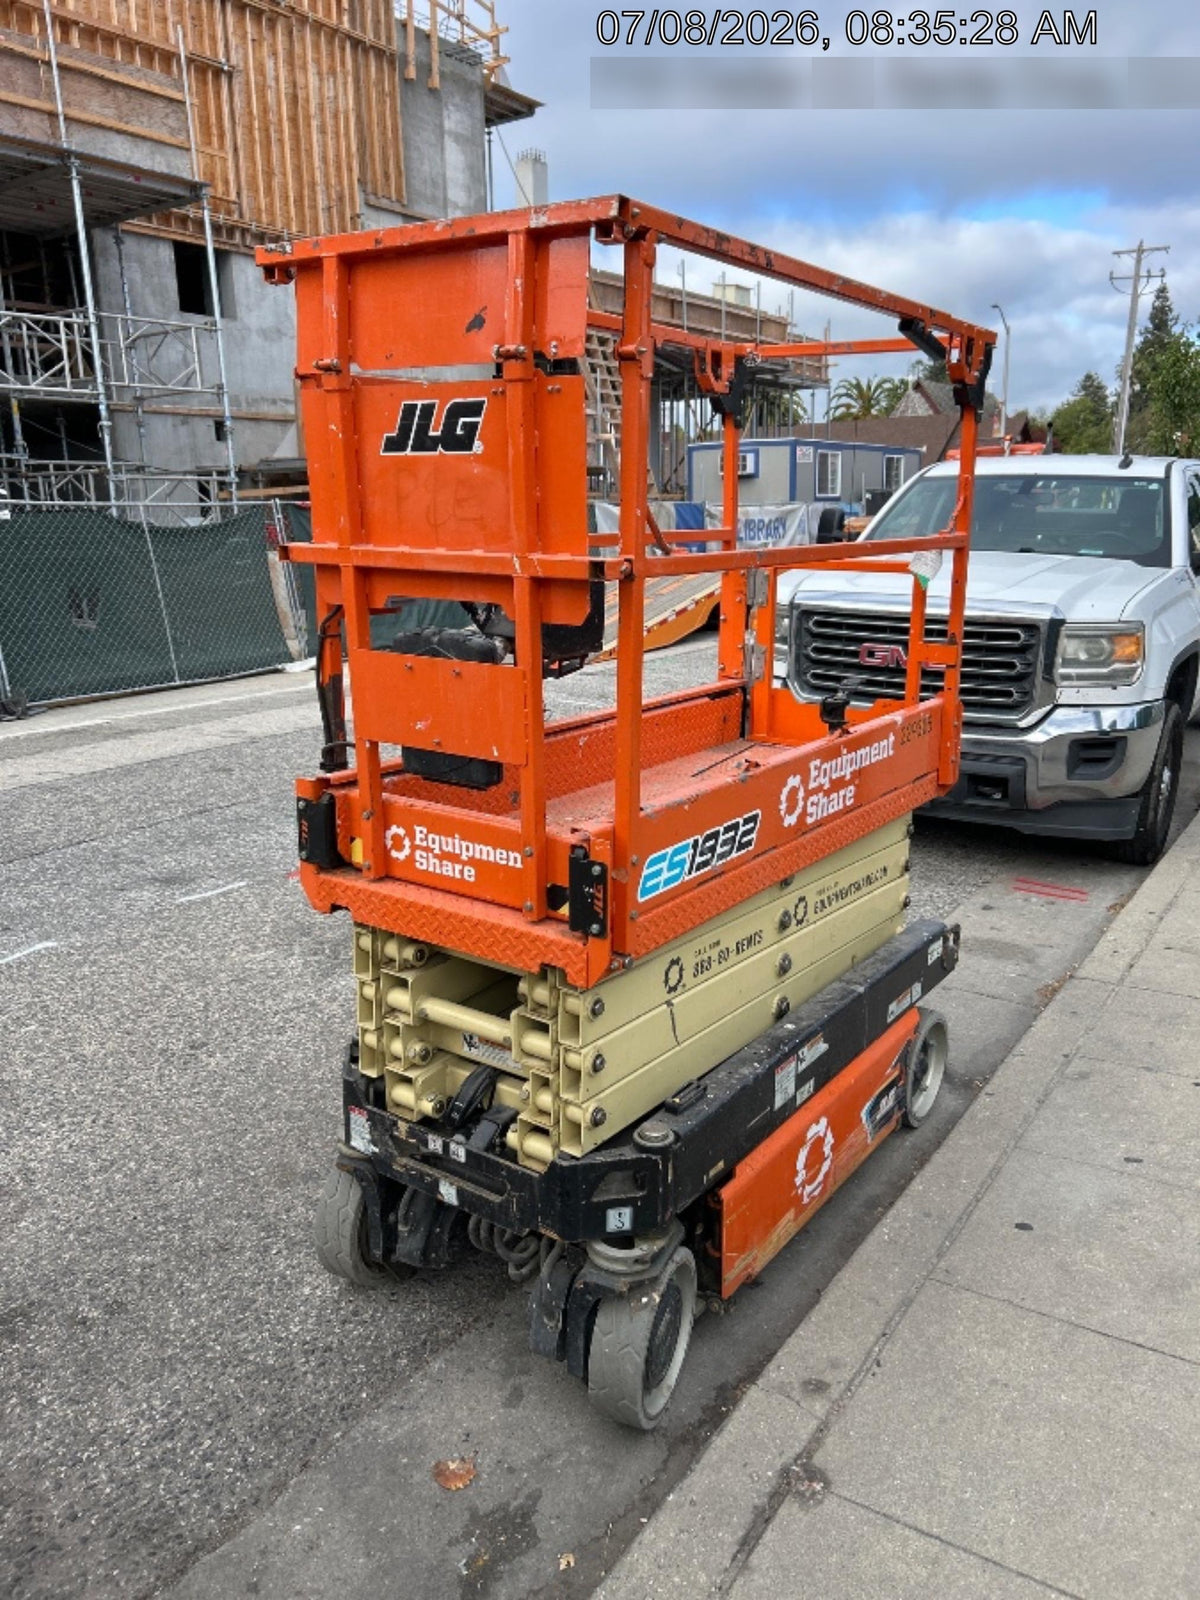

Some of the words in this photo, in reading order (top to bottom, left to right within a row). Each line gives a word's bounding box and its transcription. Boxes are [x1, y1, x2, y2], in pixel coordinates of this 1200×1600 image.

[380, 397, 488, 456] JLG
[808, 732, 895, 790] Equipment
[806, 785, 856, 824] Share
[414, 825, 523, 868] Equipmen
[415, 849, 475, 882] Share
